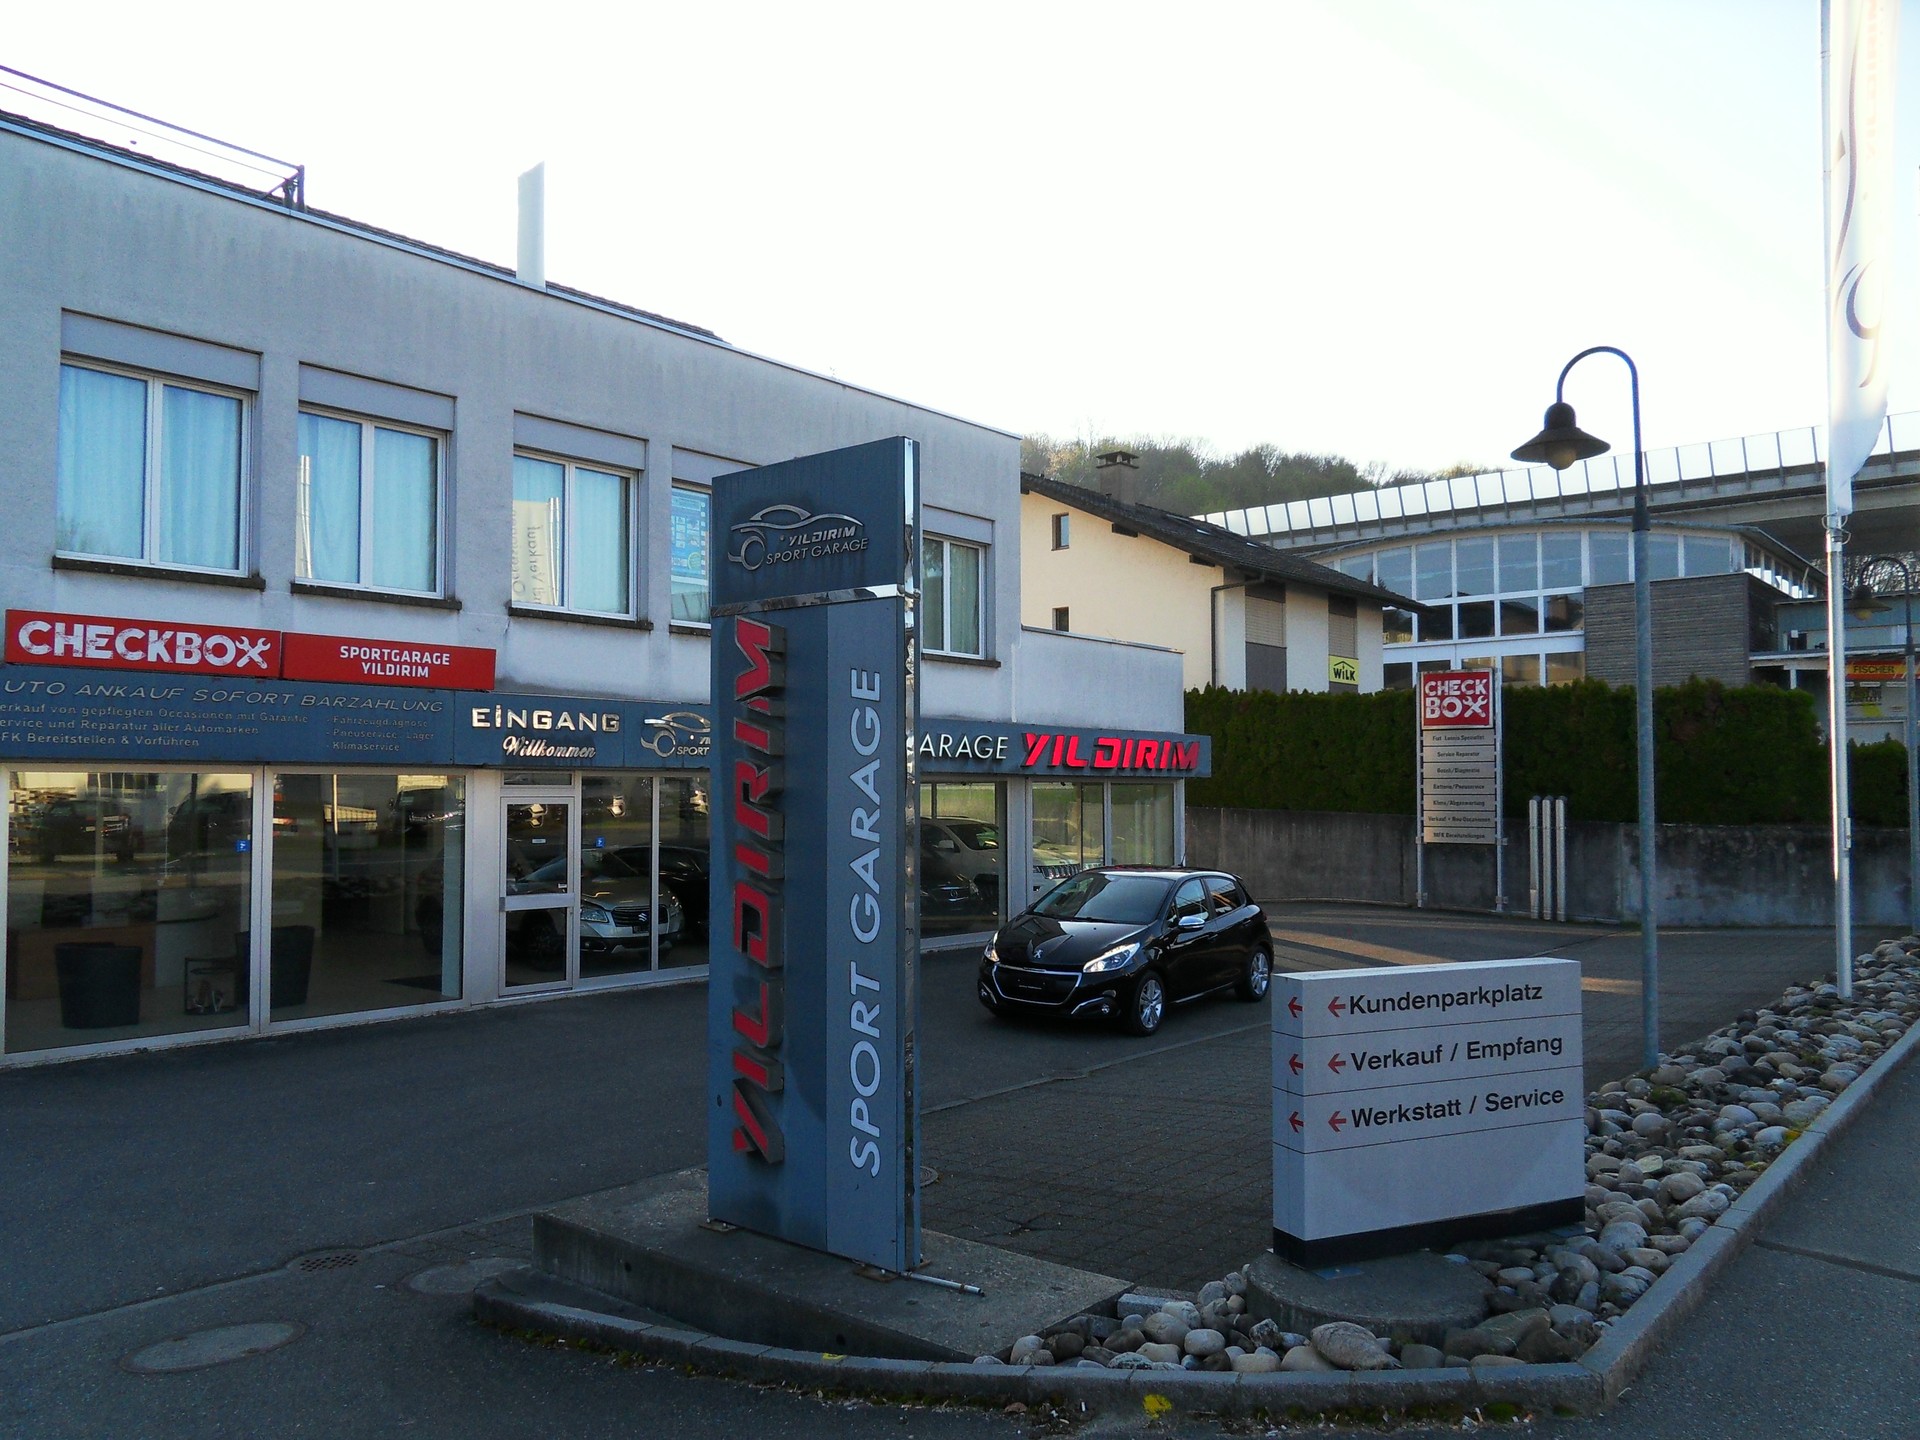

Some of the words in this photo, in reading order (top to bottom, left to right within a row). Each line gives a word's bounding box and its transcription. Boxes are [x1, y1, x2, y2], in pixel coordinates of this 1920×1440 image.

[788, 526, 856, 546] YILDIRIM
[766, 549, 808, 565] SPORT
[811, 537, 869, 557] GARAGE
[18, 620, 271, 668] CHECKBOX
[339, 645, 451, 666] SPORTGARAGE
[361, 662, 430, 679] YILDIRIM
[1853, 665, 1895, 674] FISCHER
[4, 680, 66, 694] UTO
[74, 684, 185, 700] ANKAUF
[192, 689, 294, 705] SOFORT
[300, 695, 444, 713] BARZAHLUNG
[1424, 679, 1488, 697] CHECK
[0, 703, 46, 713] erkauf
[1425, 696, 1488, 719] BOX
[0, 718, 44, 728] ervice
[49, 719, 75, 729] und
[80, 720, 147, 733] Reparatur
[183, 722, 260, 735] Automarken
[1, 731, 22, 742] FK
[26, 732, 116, 745] Bereitstellen
[120, 735, 129, 745] &
[134, 734, 200, 747] Vorführen
[502, 735, 597, 758] Willkommen
[676, 745, 710, 756] SPORT
[919, 733, 1009, 760] ARAGE
[1020, 731, 1200, 769] YILDIRIM
[849, 667, 882, 944] GARAGE
[733, 616, 786, 1165] YILDIRIM
[1350, 984, 1543, 1016] Kundenparkplatz
[1351, 1044, 1443, 1072] Verkauf
[1466, 1036, 1564, 1062] Empfang
[849, 974, 881, 1178] SPORT
[1351, 1099, 1462, 1128] Werkstatt
[1485, 1089, 1564, 1112] Service
